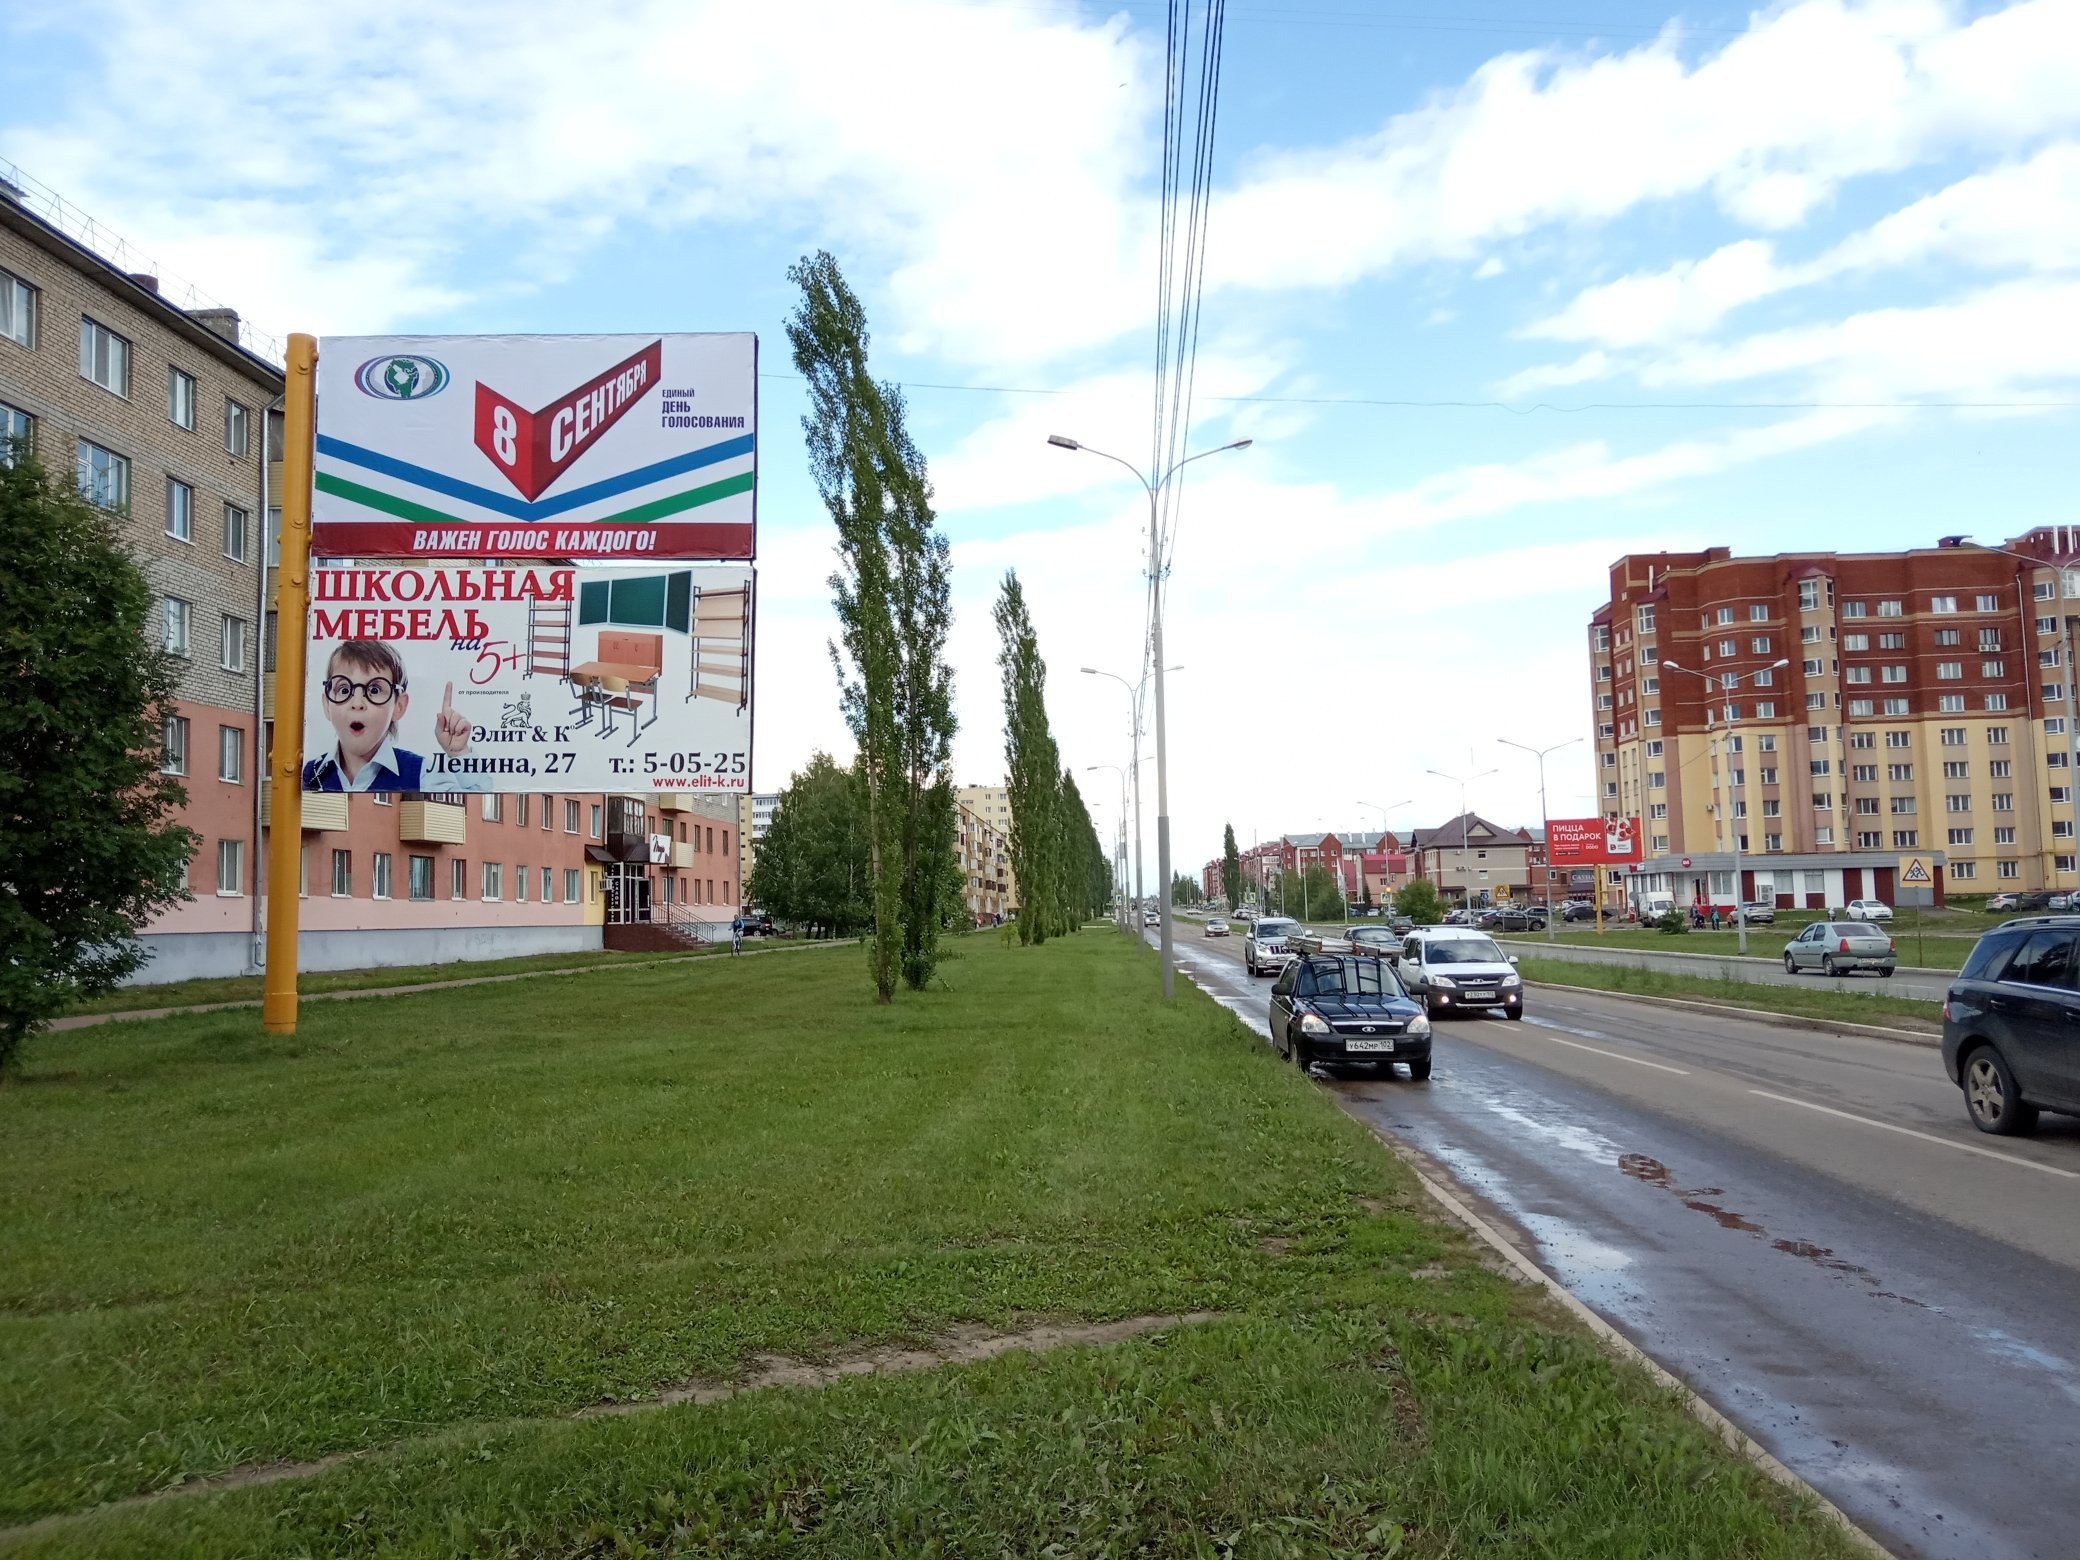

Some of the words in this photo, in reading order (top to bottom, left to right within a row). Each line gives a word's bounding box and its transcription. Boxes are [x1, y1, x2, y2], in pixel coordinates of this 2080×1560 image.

[661, 388, 695, 398] ЕДИНЫЙ
[493, 405, 517, 467] 8
[550, 359, 647, 463] СЕНТЯБРЯ
[661, 401, 691, 414] ДЕНЬ
[661, 416, 745, 428] ГОЛОСОВАНИЯ
[413, 531, 482, 550] ВАЖЕН
[486, 531, 550, 550] ГОЛОС
[556, 531, 657, 553] КАЖДОГО!
[314, 570, 576, 601] ШКОЛЬНАЯ
[313, 609, 490, 641] МЕБЕЛЬ
[450, 637, 481, 651] на
[469, 641, 527, 685] 5+
[471, 725, 527, 743] Элит
[531, 725, 549, 743] &
[426, 752, 537, 777] Ленина,
[544, 752, 577, 774] 27
[608, 757, 635, 774] т.:
[643, 751, 746, 774] 5-05-25
[652, 774, 745, 788] www.elit-k.ru
[1560, 832, 1602, 842] ПОДАРОК
